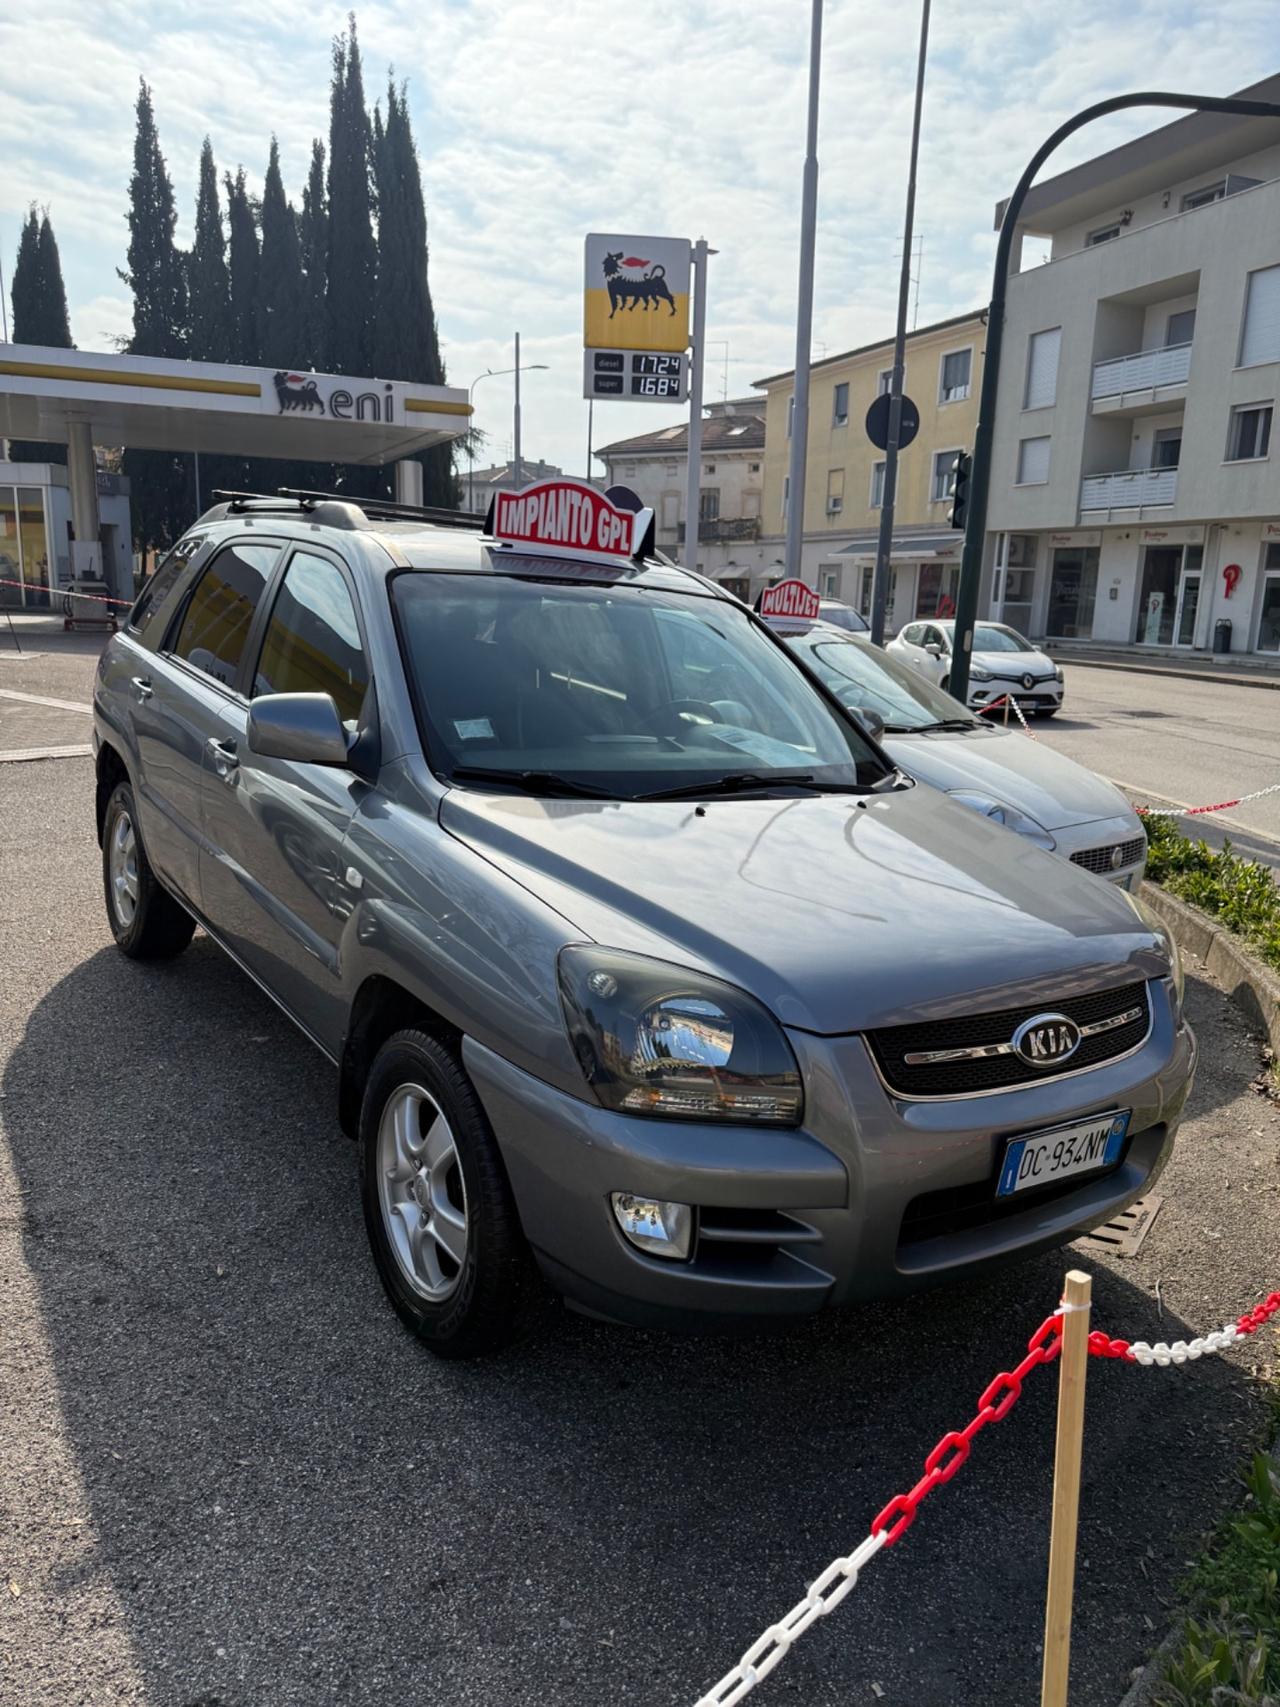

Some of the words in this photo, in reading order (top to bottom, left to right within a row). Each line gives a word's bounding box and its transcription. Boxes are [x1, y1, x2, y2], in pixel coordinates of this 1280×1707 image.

[329, 383, 394, 423] eni
[500, 489, 593, 546] IMPIANTO
[597, 508, 630, 551] GPL
[764, 584, 818, 617] MULTIJET
[1029, 1025, 1073, 1057] KIA
